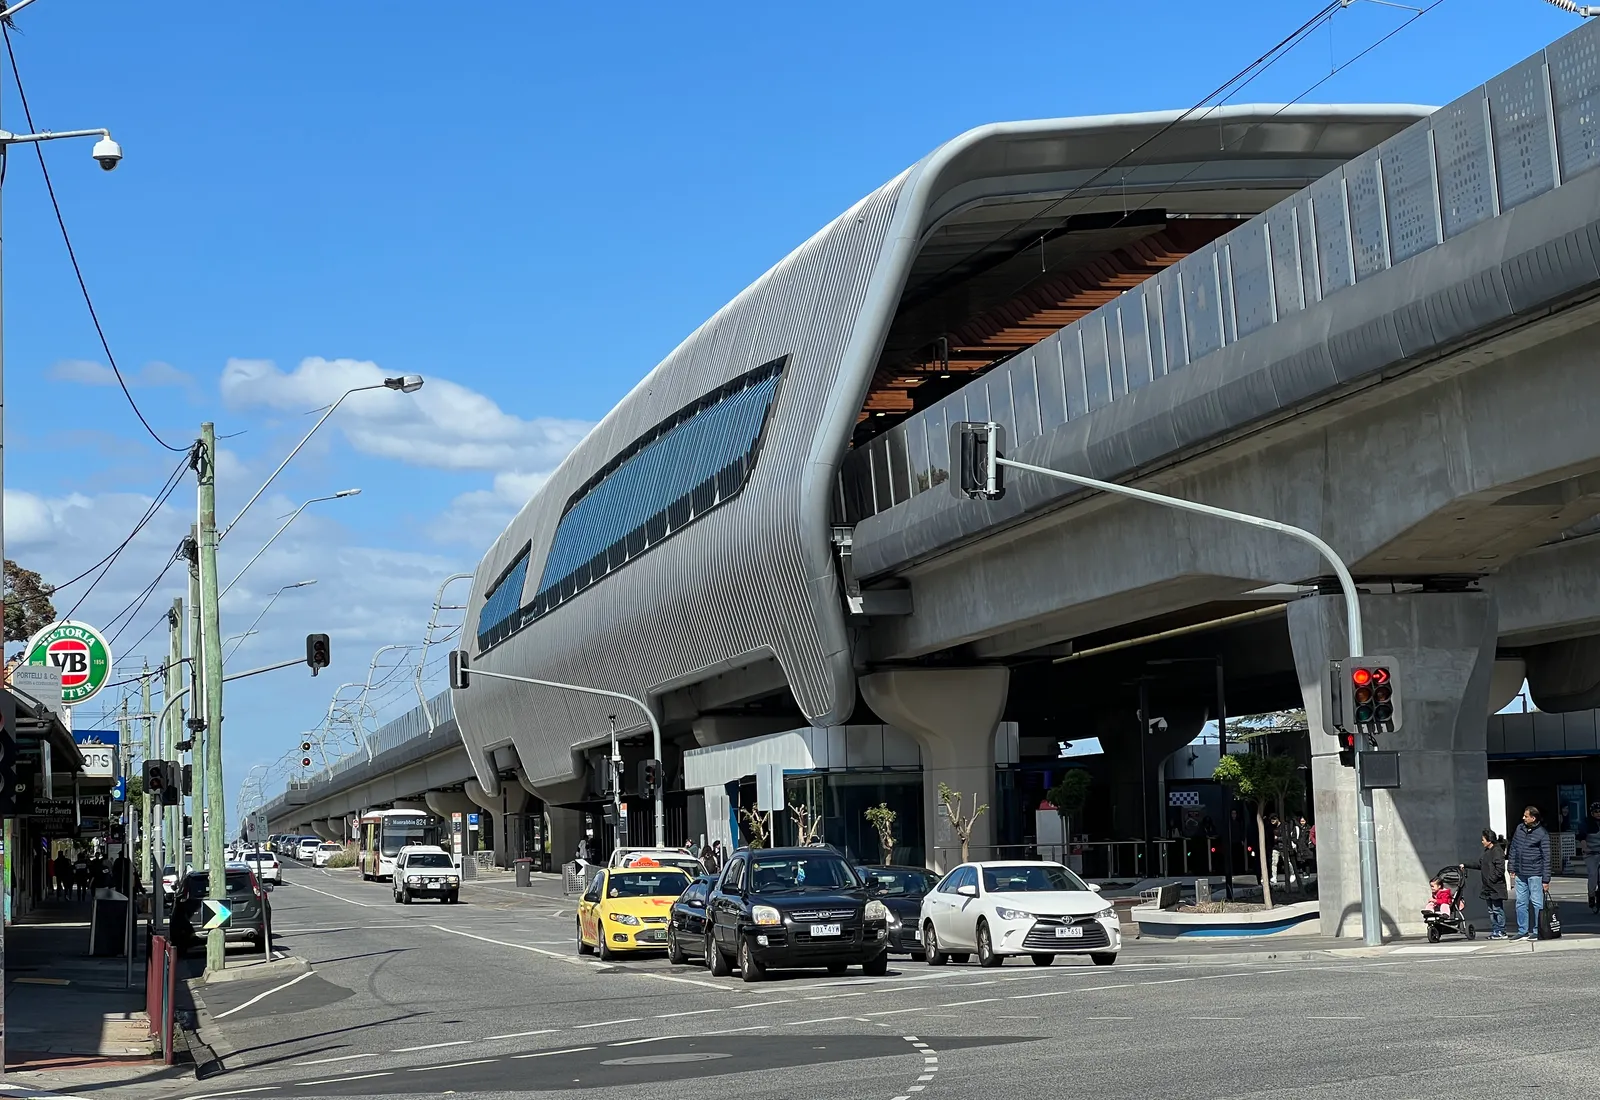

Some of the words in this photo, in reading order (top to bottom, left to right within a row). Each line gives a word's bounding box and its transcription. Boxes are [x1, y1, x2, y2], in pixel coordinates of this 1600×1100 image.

[38, 628, 96, 647] VICTORIA
[48, 652, 88, 673] VB
[16, 671, 43, 679] PORTELLI
[61, 682, 94, 698] TTER
[415, 818, 427, 826] 824
